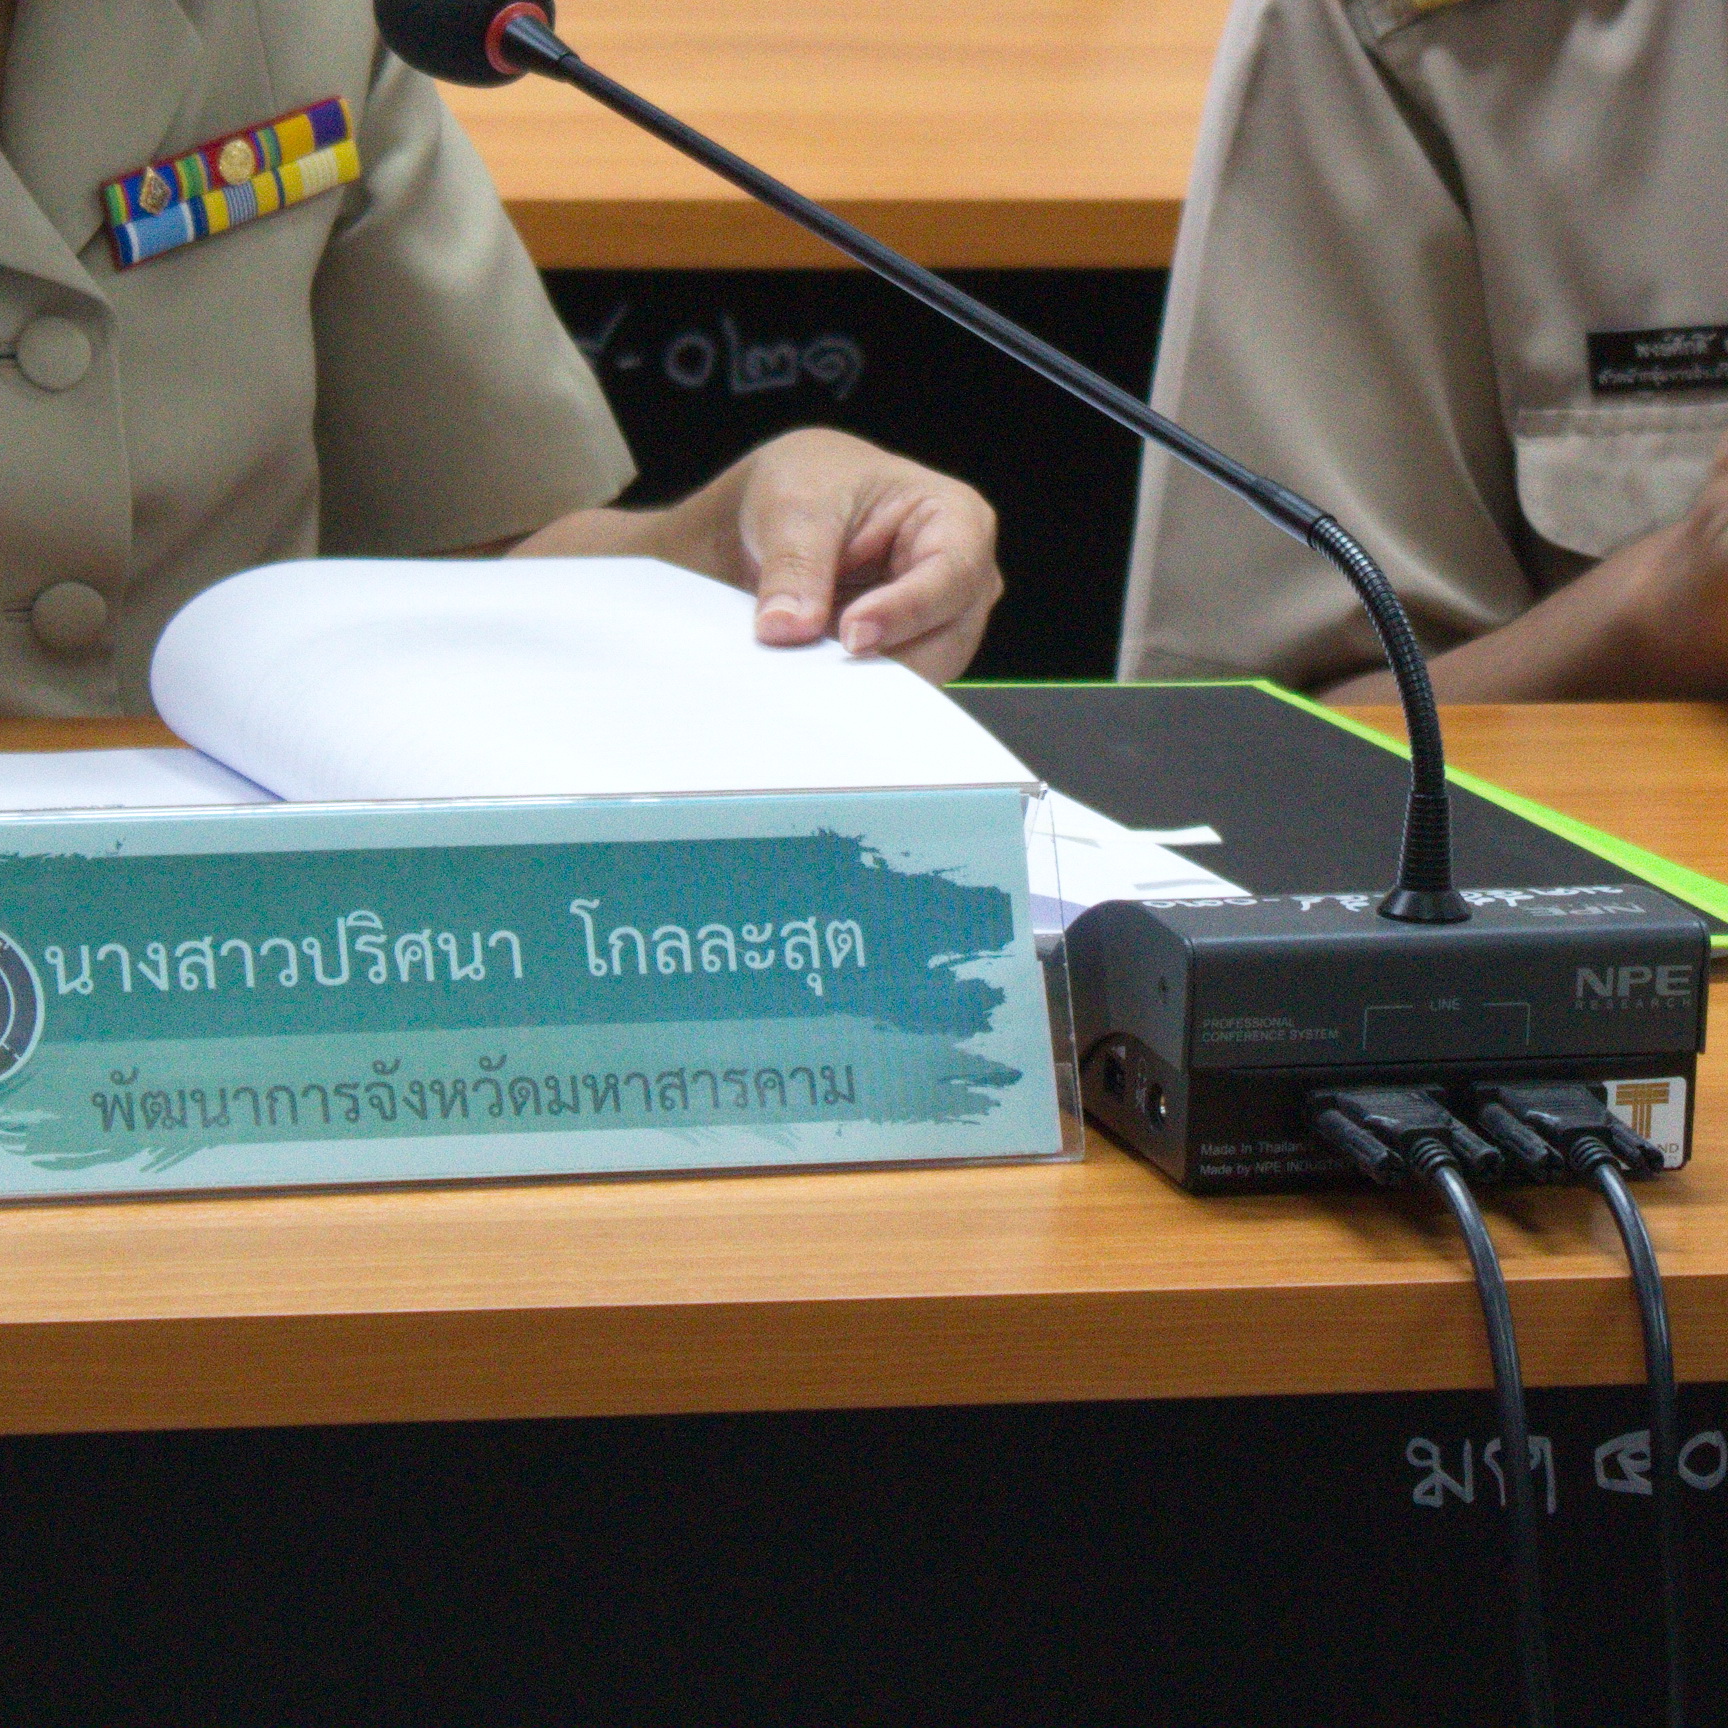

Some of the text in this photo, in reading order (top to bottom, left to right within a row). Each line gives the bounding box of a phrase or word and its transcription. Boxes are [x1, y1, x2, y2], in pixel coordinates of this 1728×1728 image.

[44, 899, 867, 996] นางสาวปริศนา โกลละสุต
[1575, 965, 1693, 997] NPE
[1429, 998, 1461, 1011] LINE
[1203, 1017, 1294, 1029] PROFESSIONAL
[1202, 1028, 1339, 1042] CONFERENCE SYSTEM
[92, 1053, 857, 1133] พัฒนาการจังหวัดมหาสารคาม
[1200, 1143, 1236, 1156] Made
[1200, 1164, 1233, 1176] Made
[1237, 1164, 1251, 1177] by
[1256, 1160, 1281, 1173] NPE
